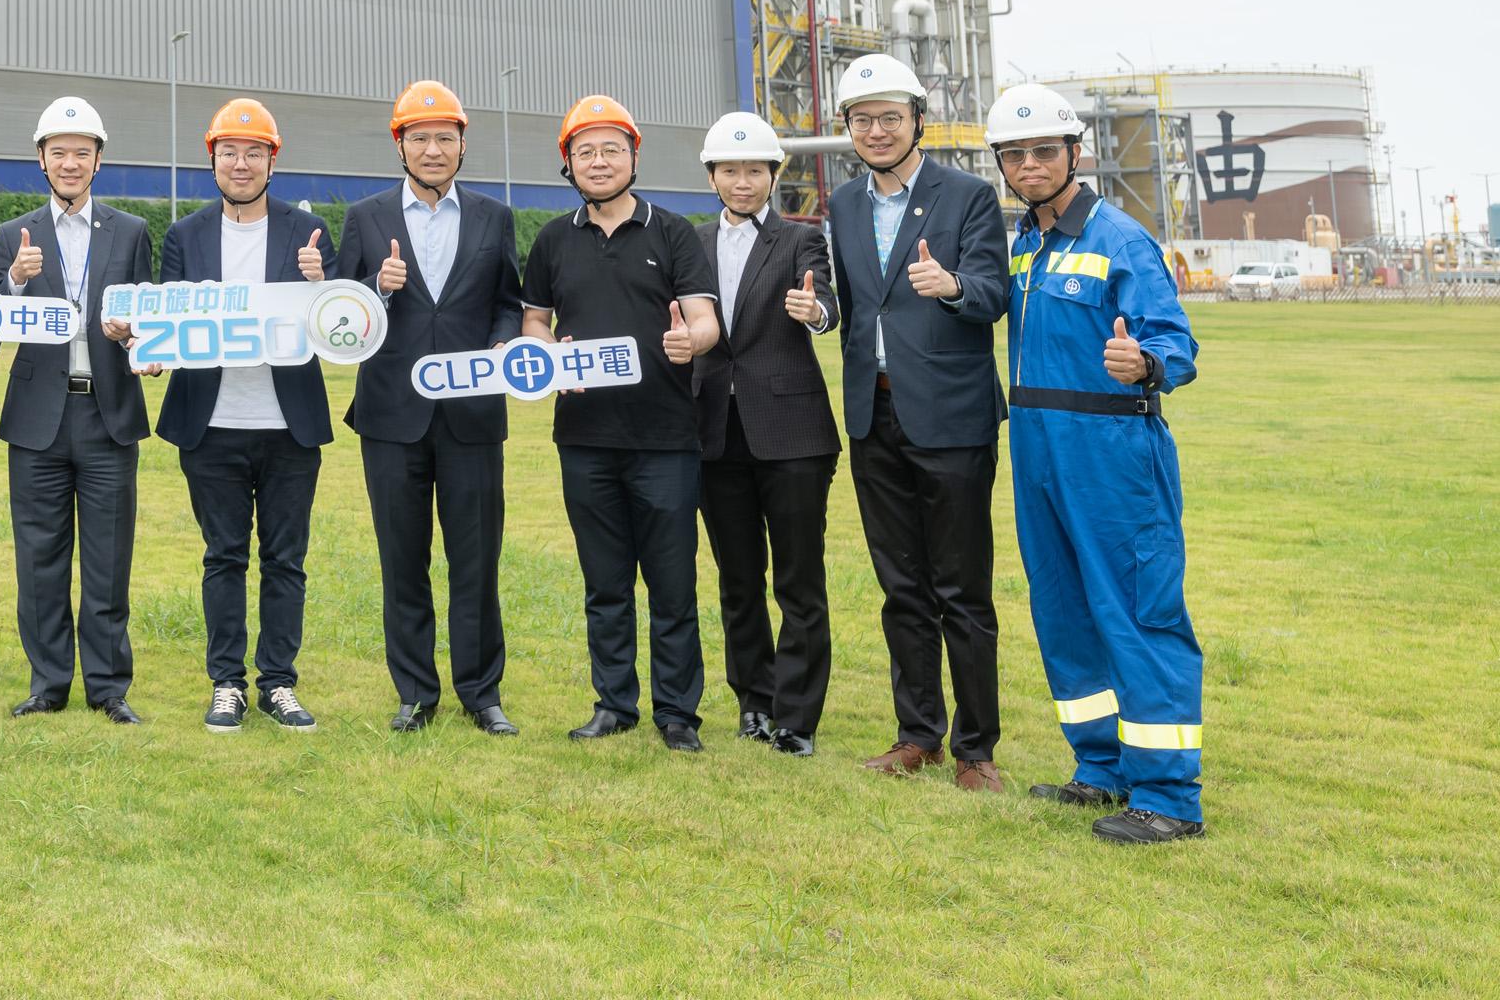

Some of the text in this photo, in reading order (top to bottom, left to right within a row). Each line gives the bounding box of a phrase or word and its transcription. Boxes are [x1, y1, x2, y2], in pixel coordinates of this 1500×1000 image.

[108, 285, 249, 317] 邁向碳中和
[10, 305, 71, 337] 中電
[136, 316, 307, 363] 2050
[418, 357, 495, 392] CLP
[562, 344, 633, 381] 中電
